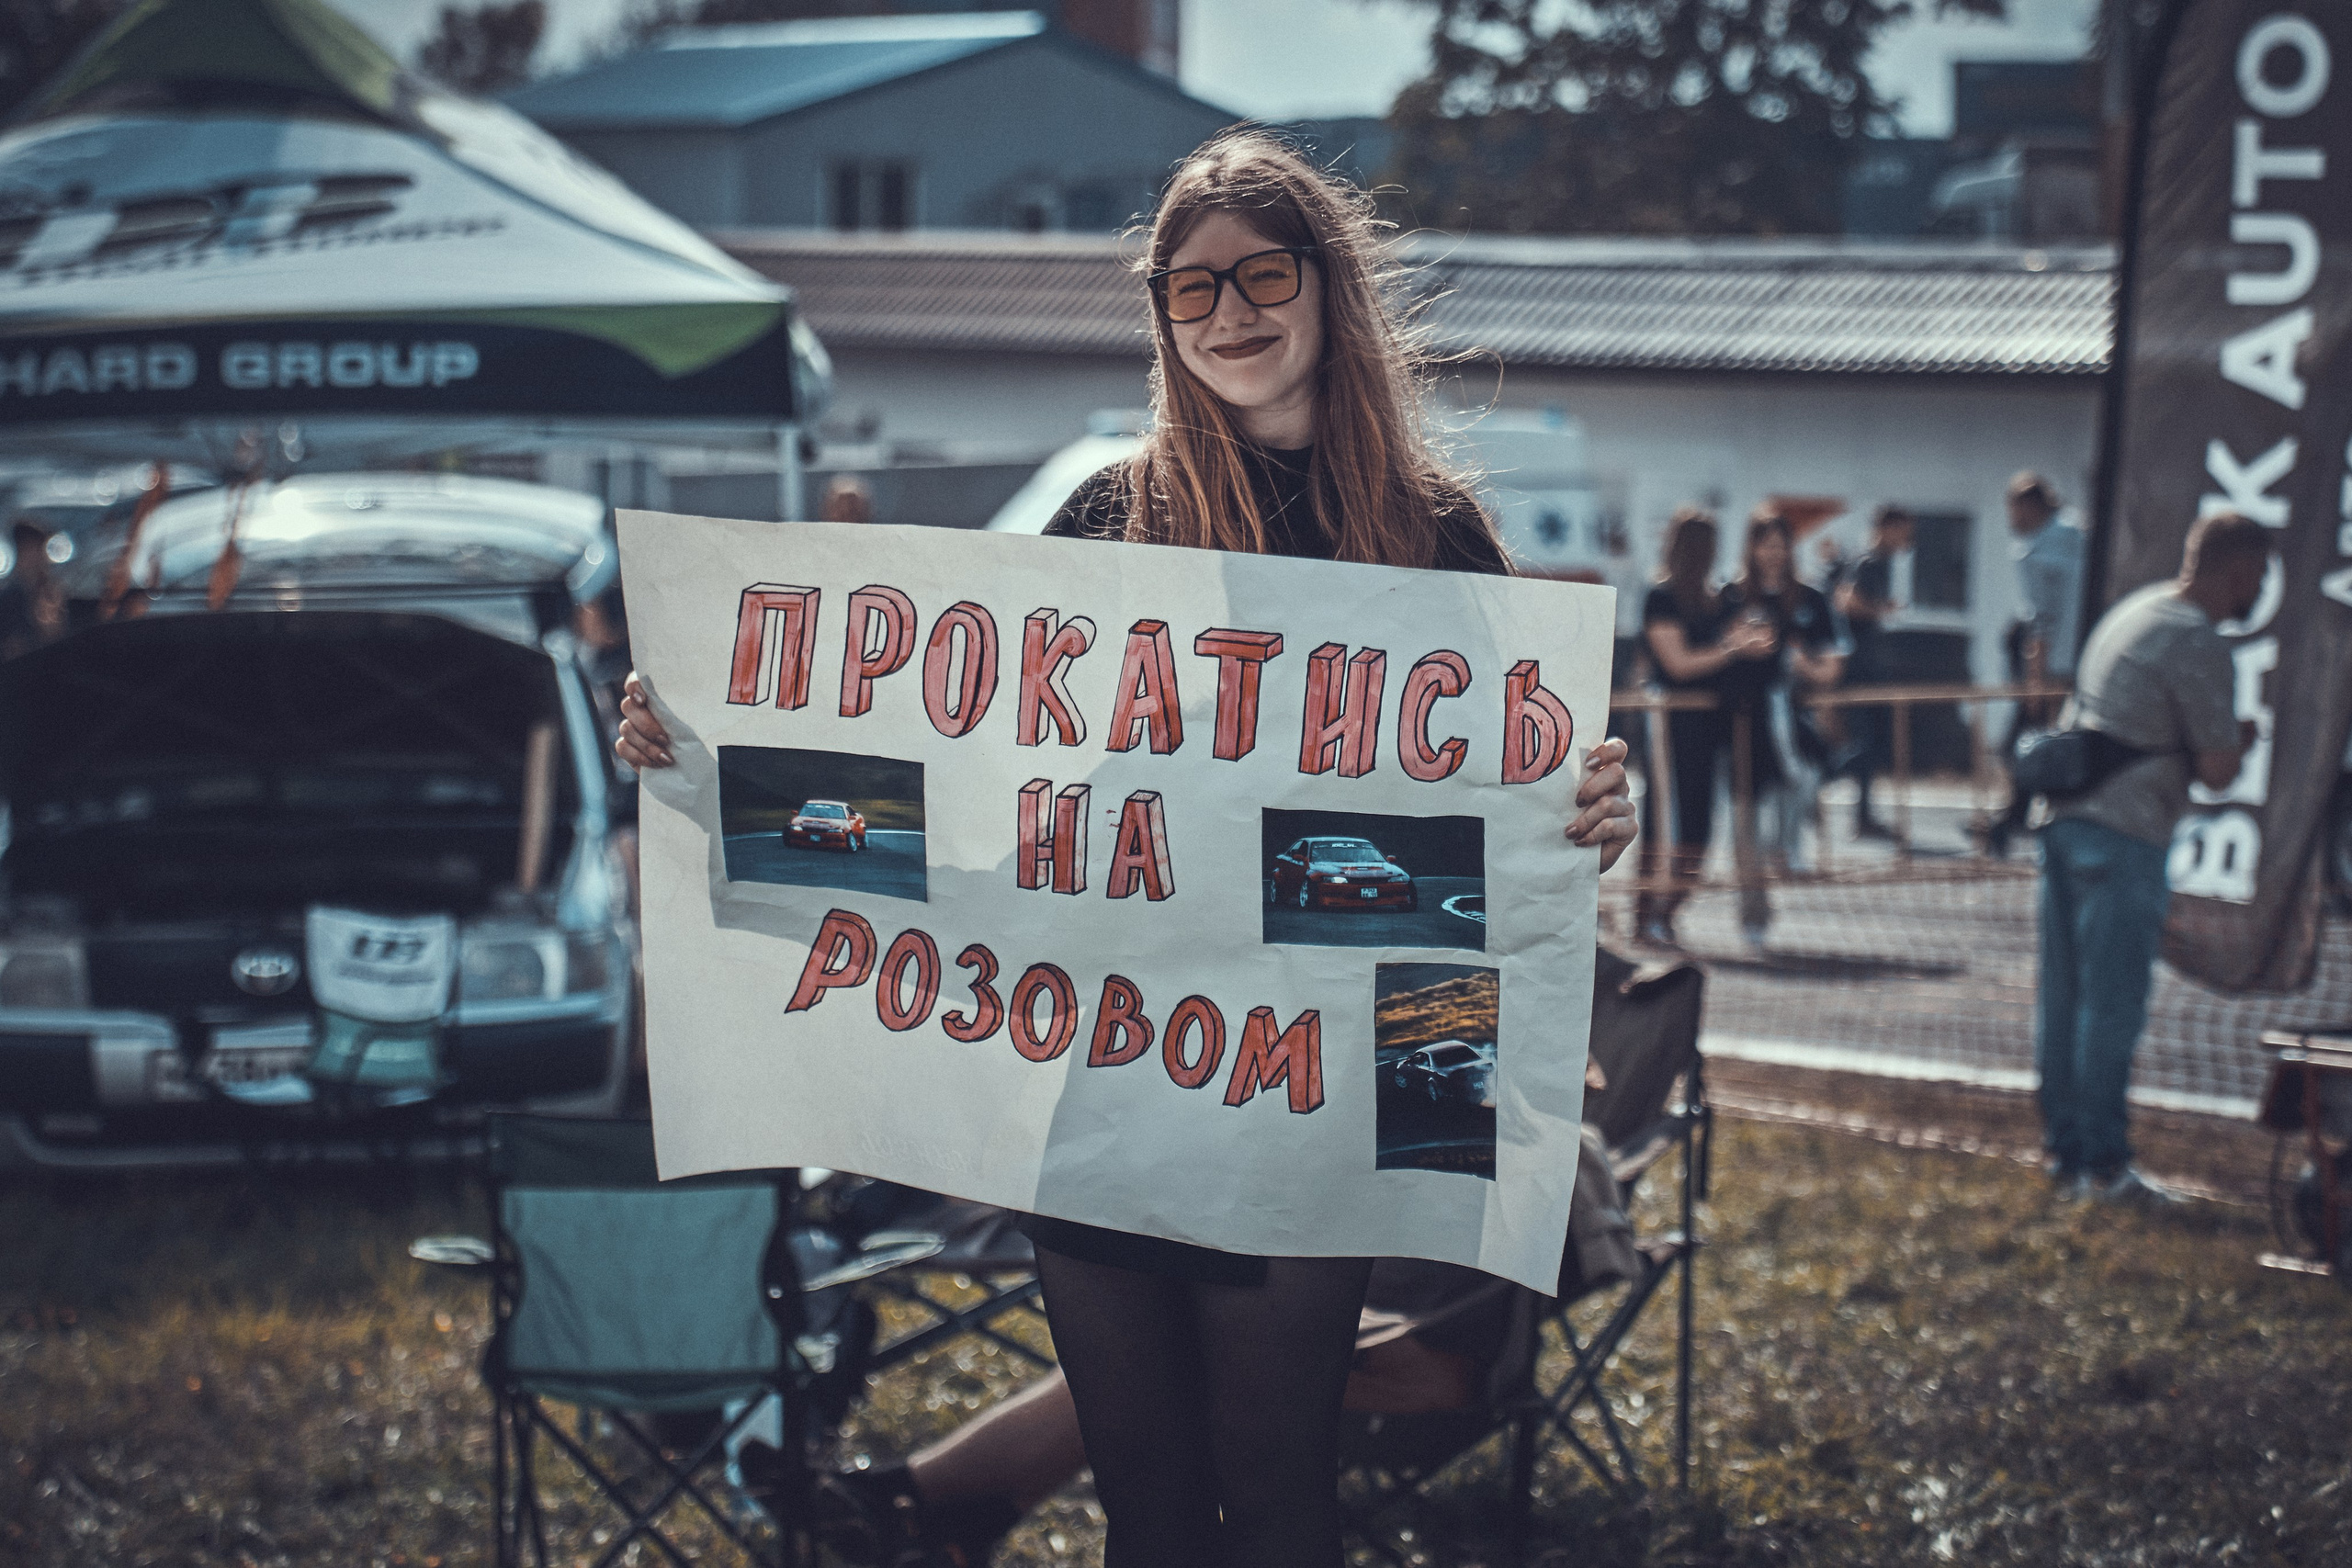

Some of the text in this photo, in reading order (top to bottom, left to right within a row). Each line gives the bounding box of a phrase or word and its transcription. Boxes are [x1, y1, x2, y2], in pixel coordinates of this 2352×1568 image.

[2220, 13, 2333, 412] AUTO
[220, 339, 481, 389] GROUP
[725, 581, 1574, 785] ПРОКАТИСЬ
[1017, 777, 1176, 903] НА
[785, 908, 1327, 1115] РОЗОВОМ
